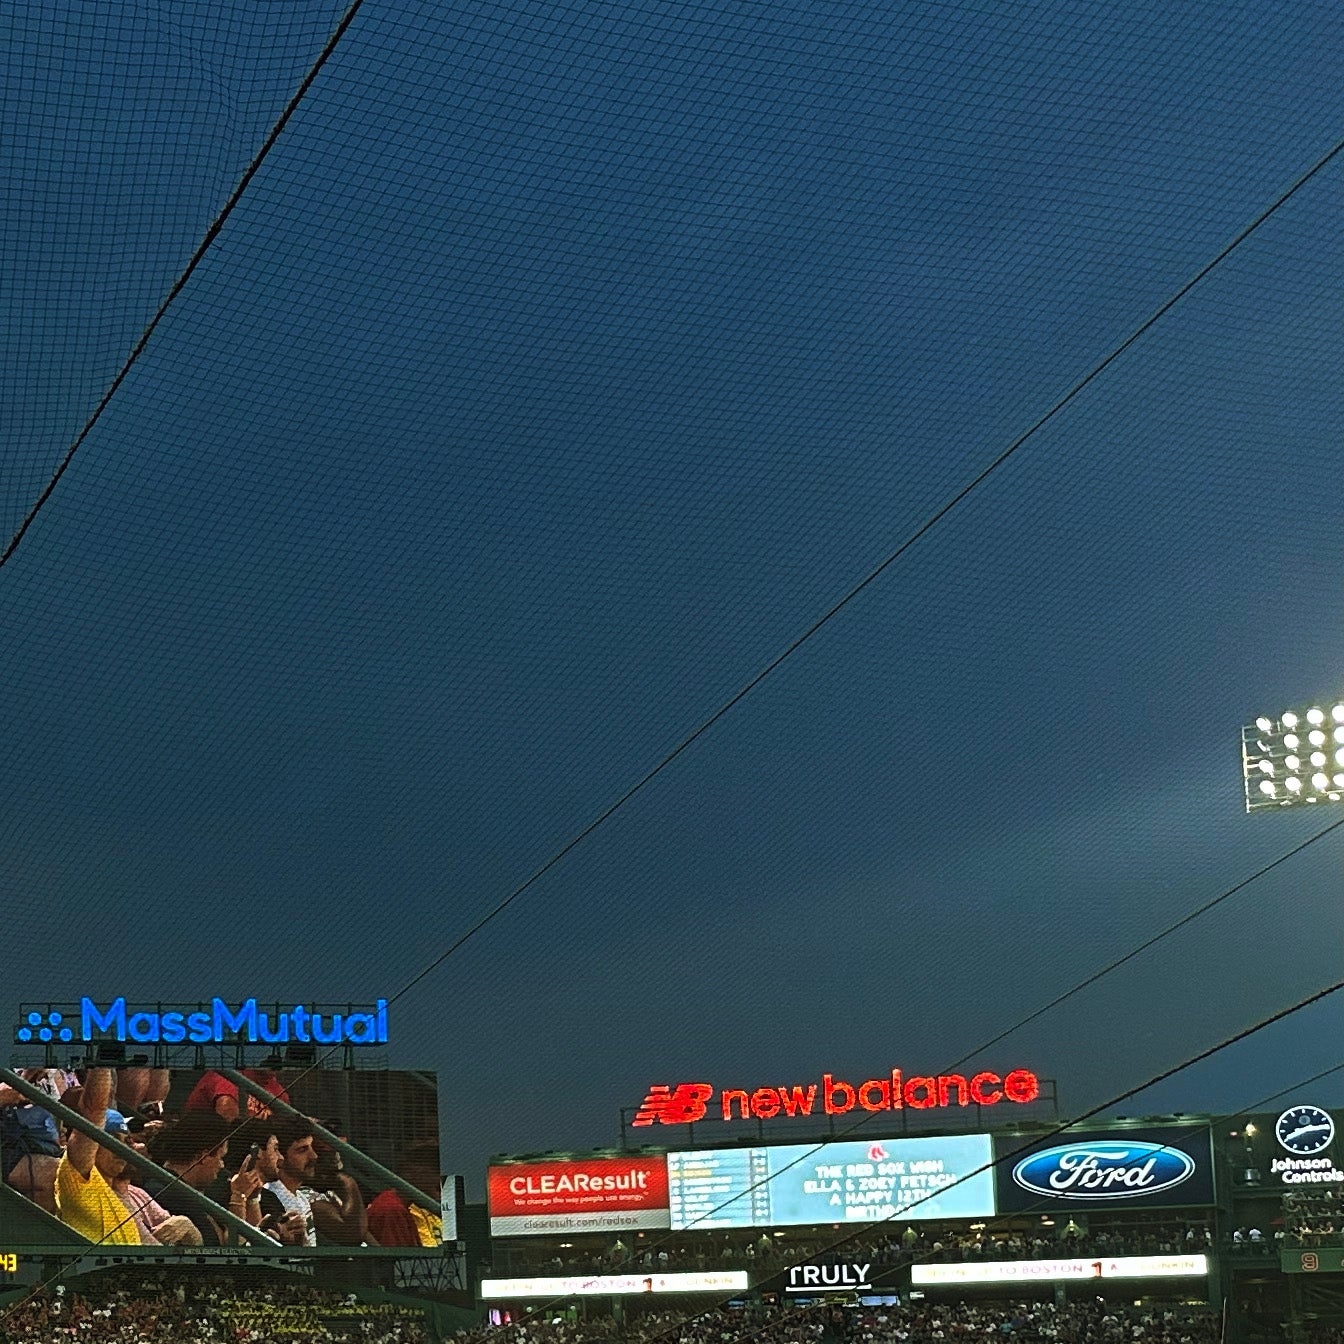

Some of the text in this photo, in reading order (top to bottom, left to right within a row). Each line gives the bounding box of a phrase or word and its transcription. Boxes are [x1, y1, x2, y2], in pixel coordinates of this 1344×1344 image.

[80, 996, 389, 1043] MassMutual
[721, 1068, 1040, 1121] new balance
[847, 1163, 873, 1177] RED
[877, 1161, 907, 1175] SOX
[1049, 1150, 1158, 1190] Ford
[1271, 1157, 1332, 1173] Johnson
[1282, 1167, 1344, 1183] Controls
[509, 1169, 648, 1196] CLEAResult
[846, 1190, 894, 1205] HAPPY
[1301, 1252, 1319, 1272] 9
[788, 1263, 871, 1285] TRULY
